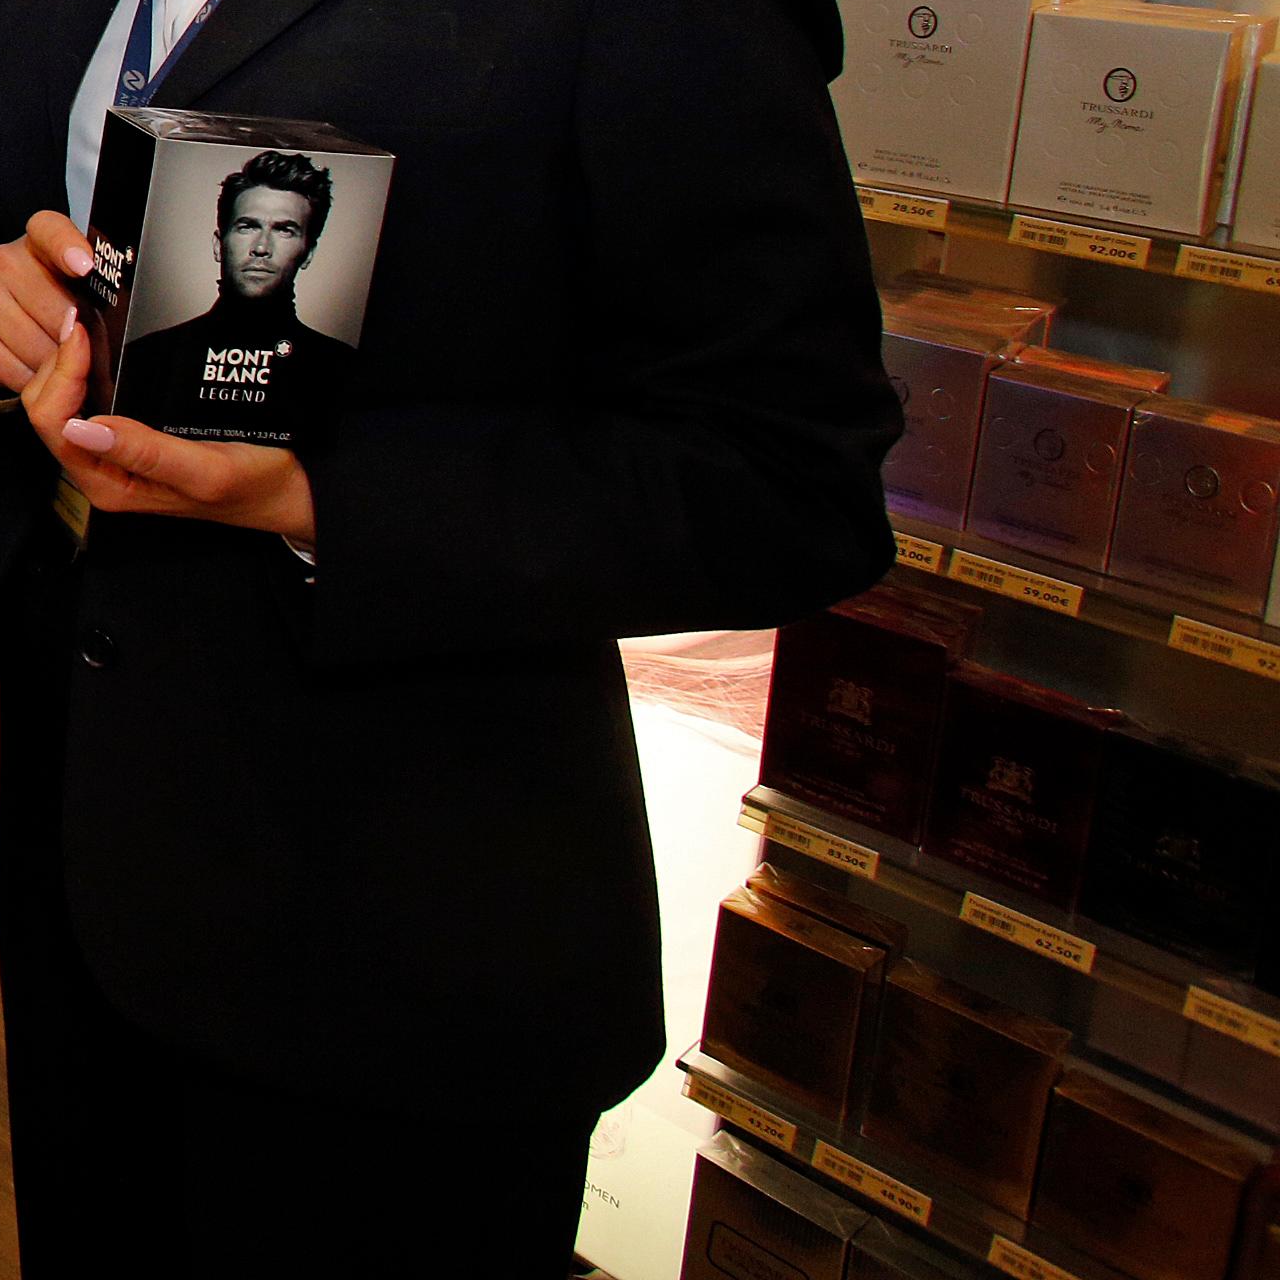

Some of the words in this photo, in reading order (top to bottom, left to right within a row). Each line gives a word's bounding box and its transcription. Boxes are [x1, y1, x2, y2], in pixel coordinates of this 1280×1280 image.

[889, 39, 952, 54] TRUSSARDI
[1080, 101, 1154, 120] TRUSSARDI
[95, 236, 124, 269] MONT
[94, 253, 121, 288] BLANC
[207, 348, 273, 367] MONT
[203, 365, 270, 385] BLANC
[200, 388, 265, 402] LEGEND
[190, 428, 221, 436] TOILETTE
[898, 548, 932, 565] 3,00€
[584, 1180, 620, 1208] OMEN
